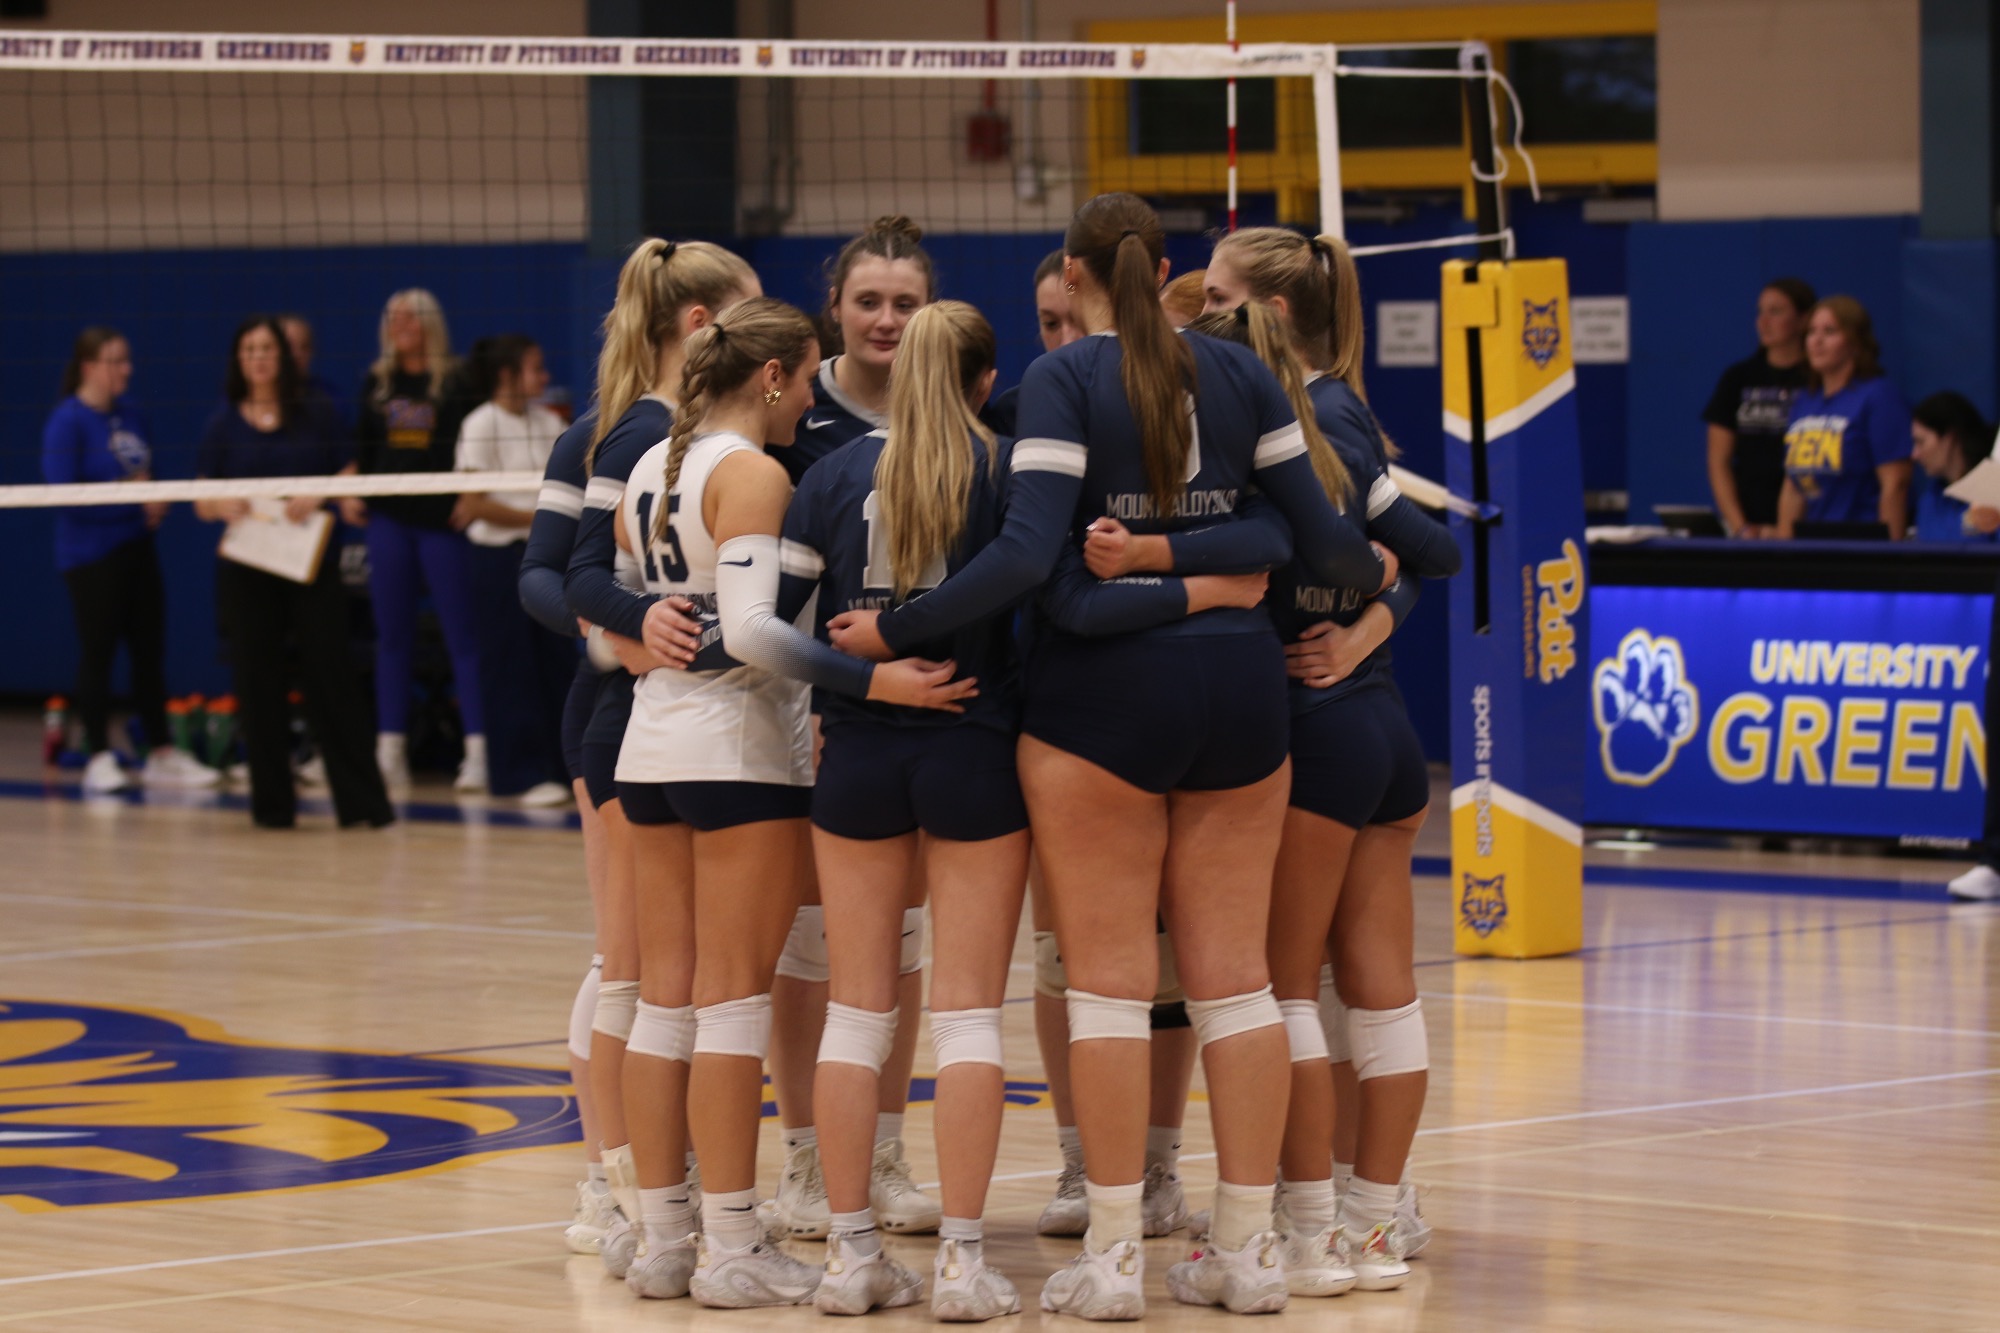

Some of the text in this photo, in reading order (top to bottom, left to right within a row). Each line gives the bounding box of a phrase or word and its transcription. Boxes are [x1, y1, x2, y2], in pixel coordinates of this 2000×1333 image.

[384, 43, 484, 63] UNIVERSITY
[789, 47, 883, 66] UNIVERSITY
[636, 492, 690, 583] 15
[862, 489, 949, 590] 1
[1536, 538, 1585, 684] Pitt
[1750, 639, 1979, 690] UNIVERSITY
[1471, 685, 1493, 760] sports
[1707, 691, 1987, 792] GREEN
